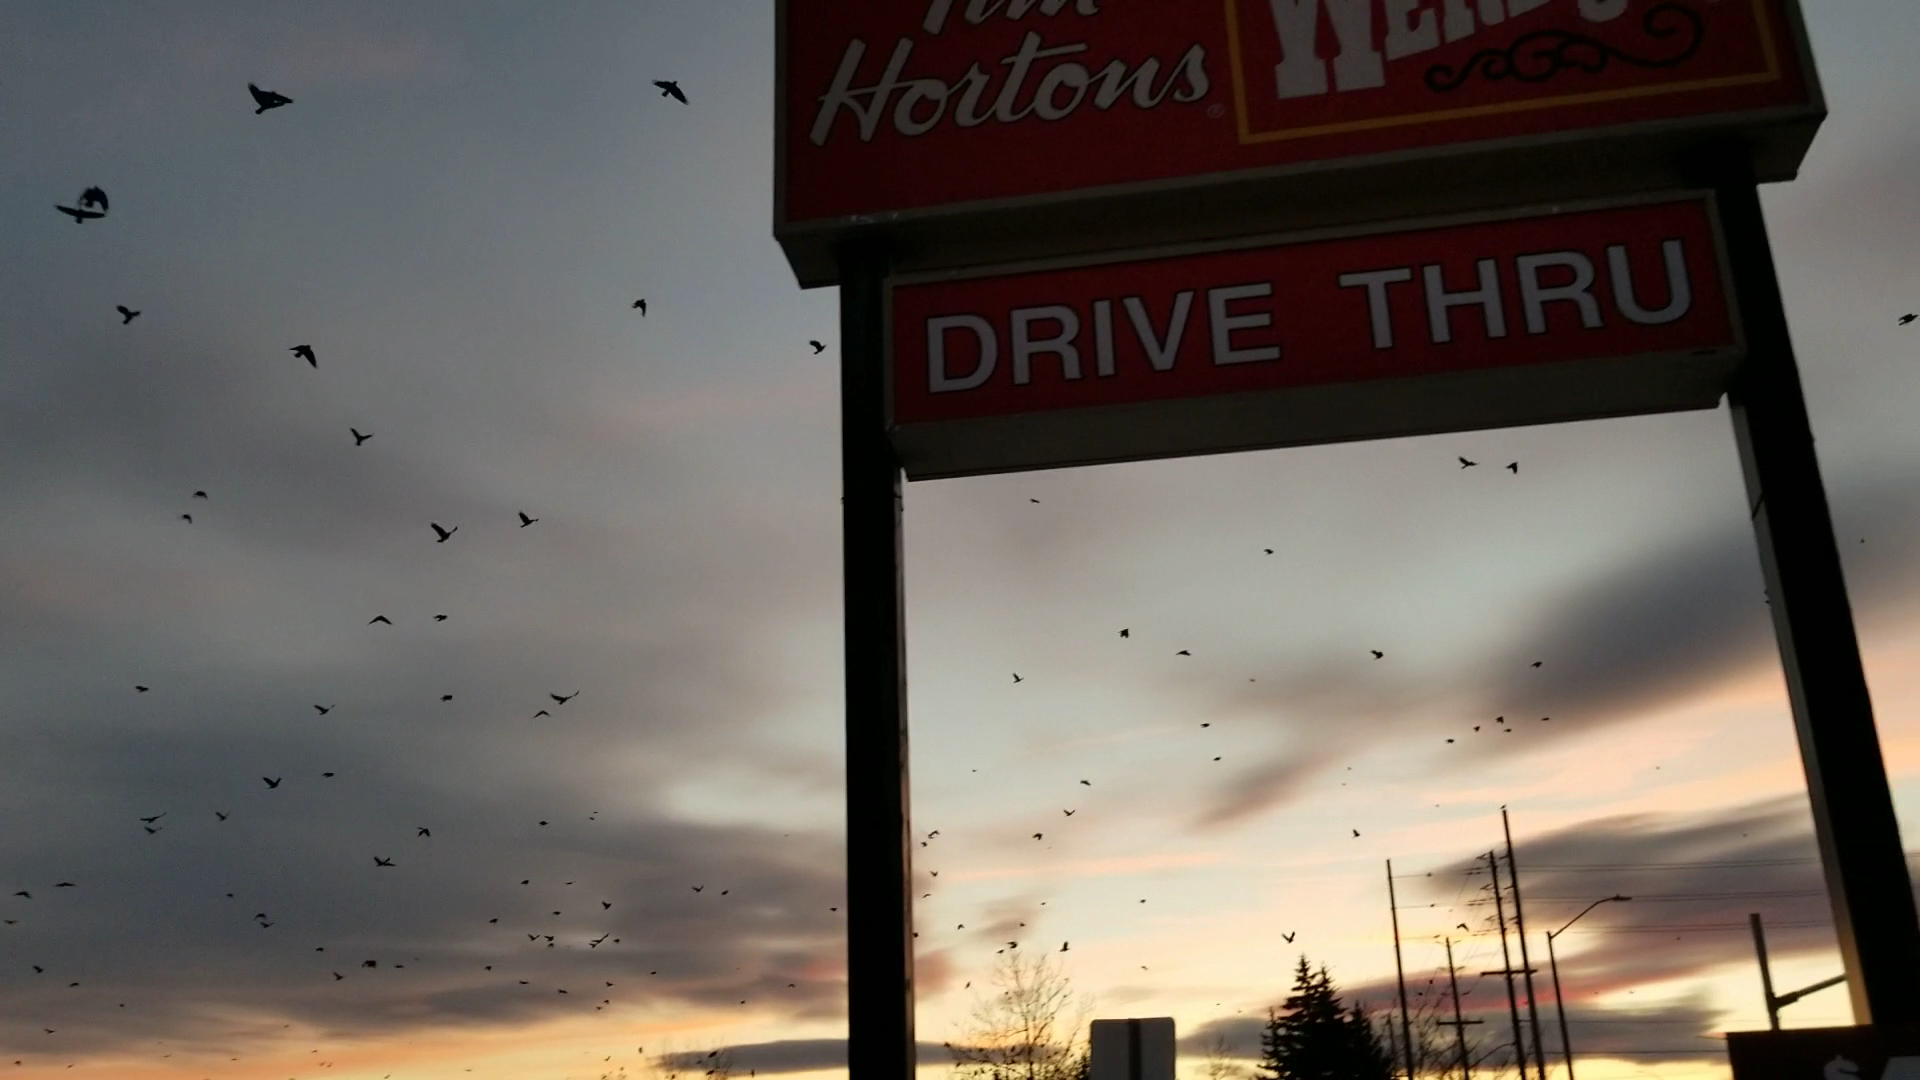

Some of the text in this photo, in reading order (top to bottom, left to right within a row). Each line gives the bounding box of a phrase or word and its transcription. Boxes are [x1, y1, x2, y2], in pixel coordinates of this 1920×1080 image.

[809, 31, 1210, 146] Hortons
[926, 239, 1692, 394] DRIVE THRU
